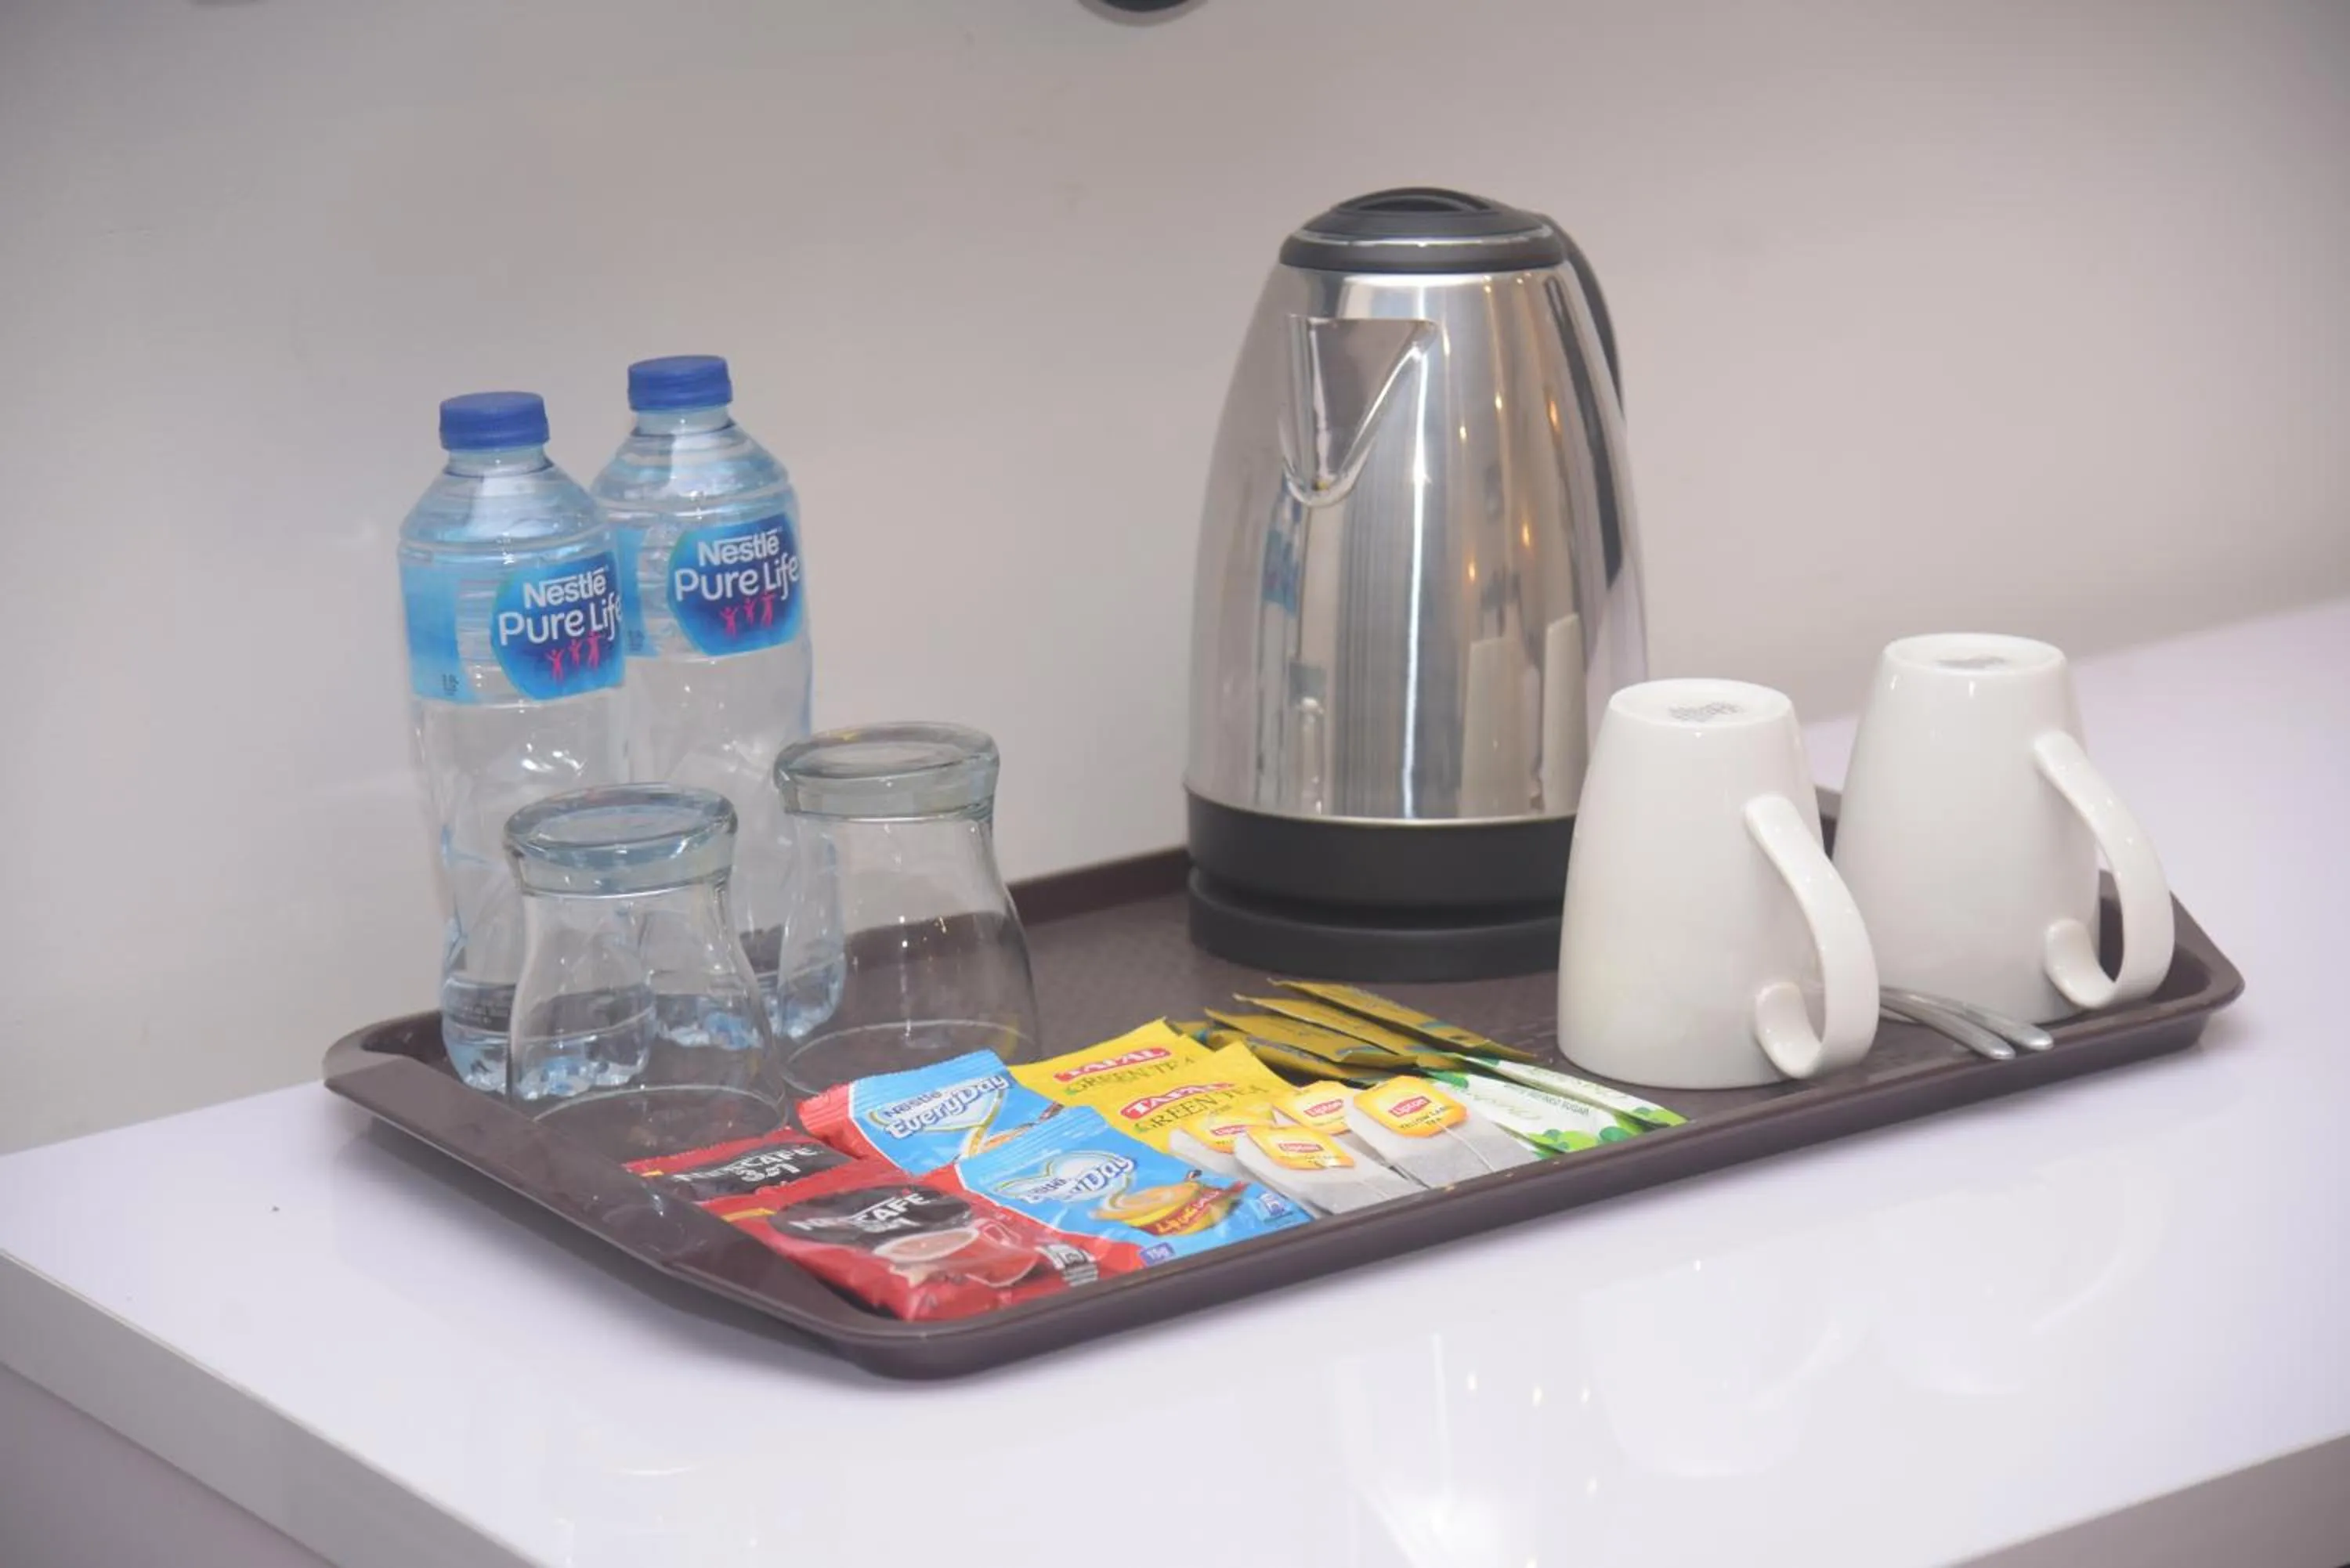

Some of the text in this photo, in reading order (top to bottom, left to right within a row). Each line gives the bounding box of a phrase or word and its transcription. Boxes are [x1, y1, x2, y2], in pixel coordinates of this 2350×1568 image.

[674, 552, 801, 602] Pure Life
[499, 609, 585, 645] Pure
[885, 1074, 1010, 1139] EveryDay
[1135, 1093, 1218, 1133] GREEN
